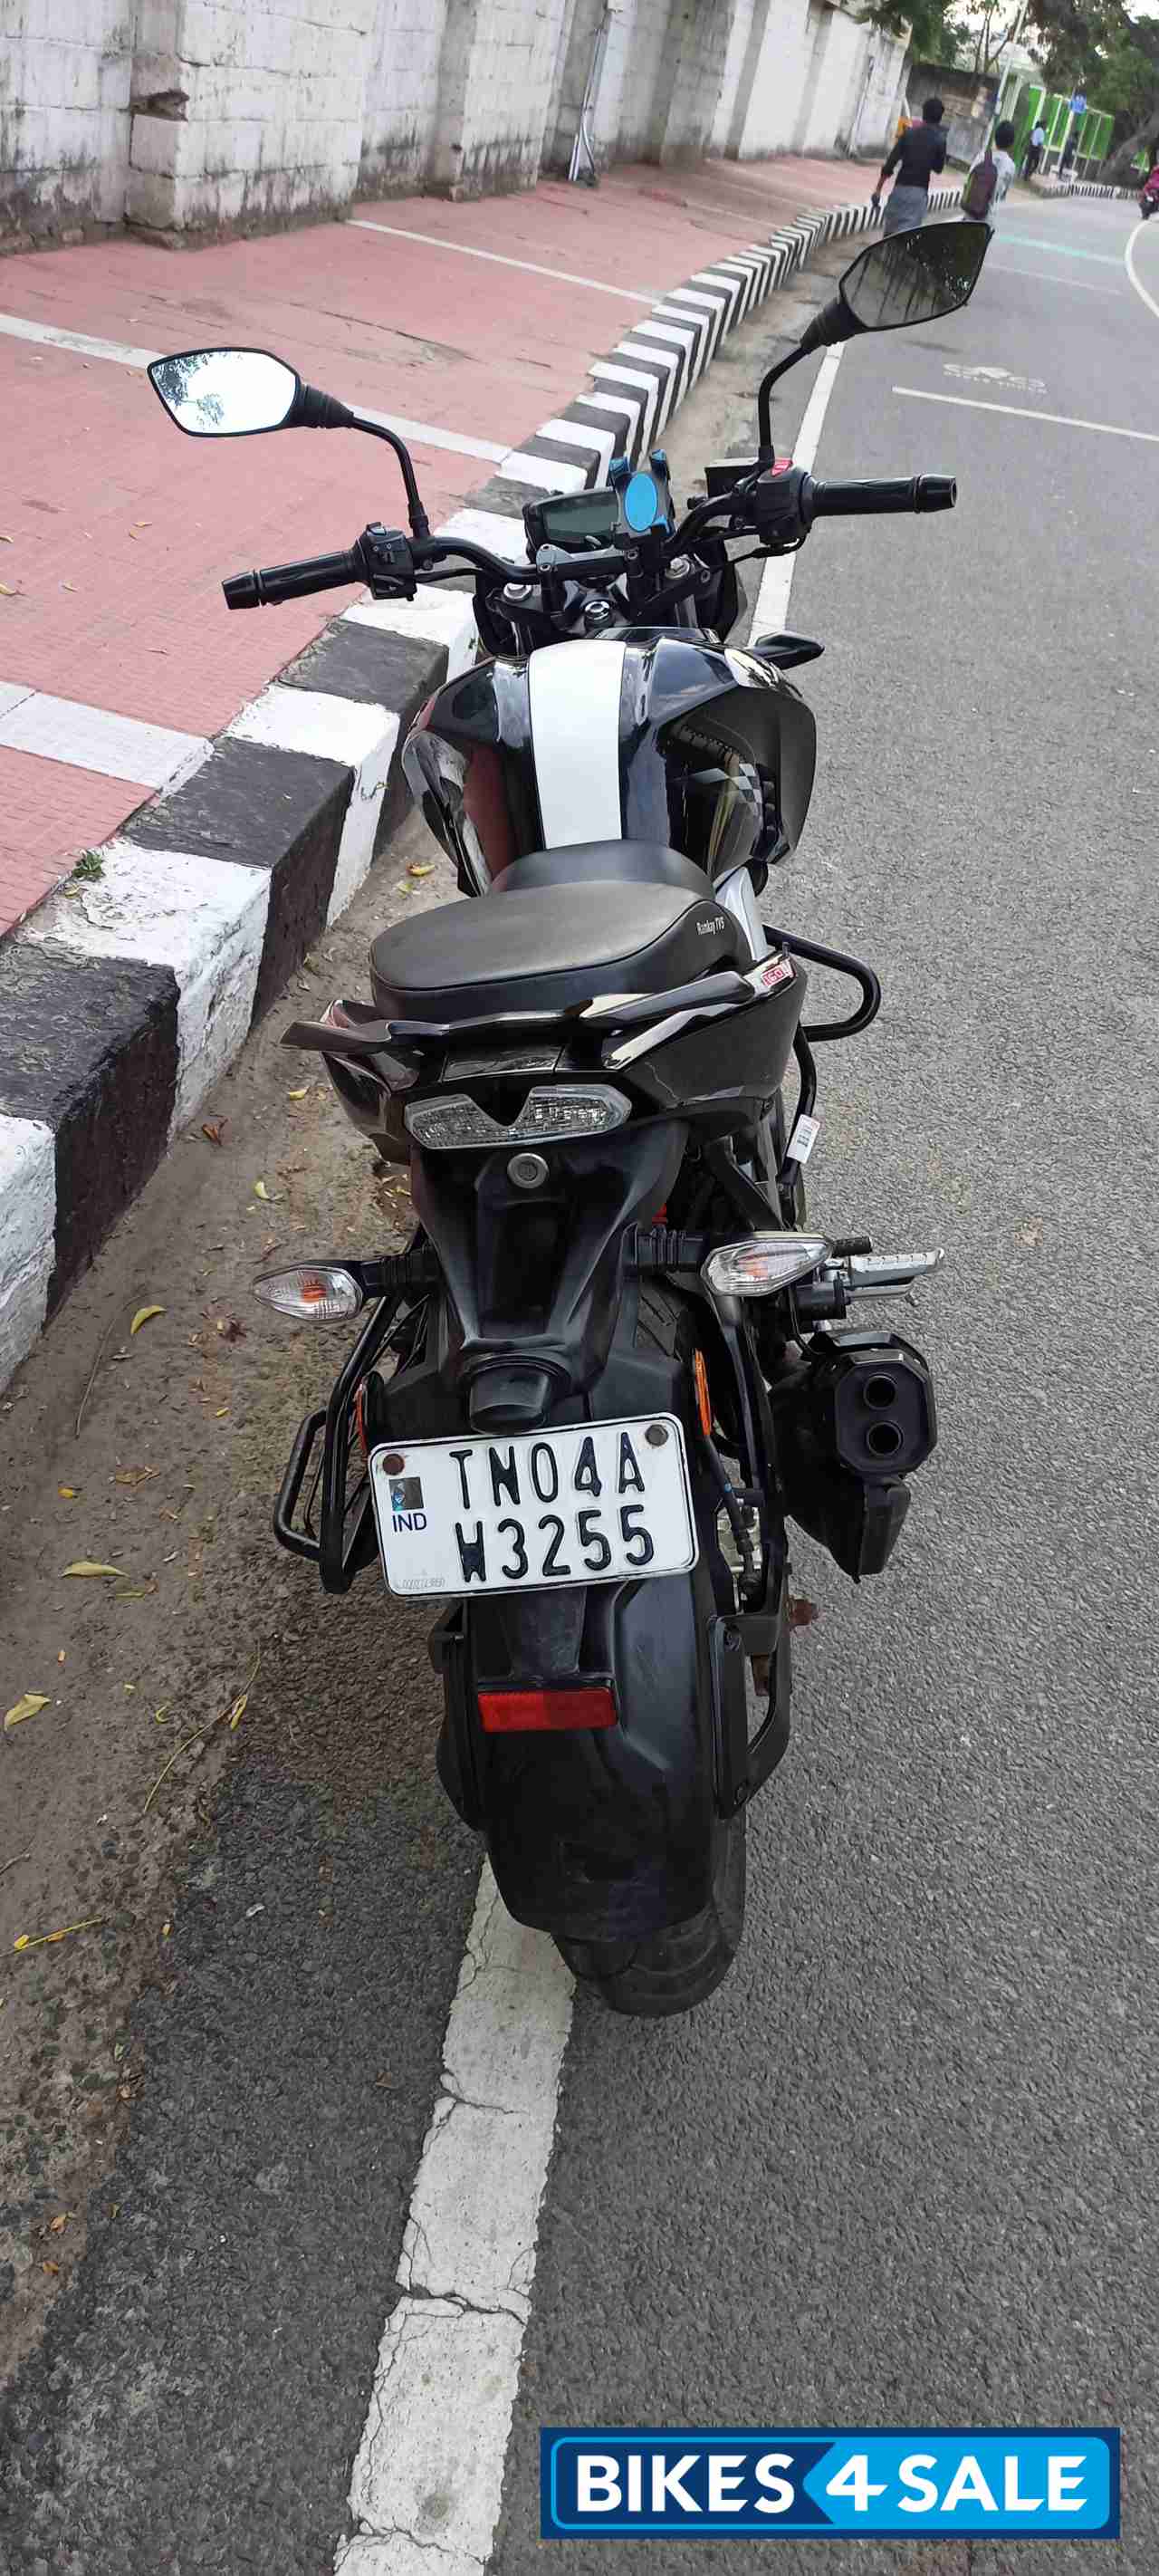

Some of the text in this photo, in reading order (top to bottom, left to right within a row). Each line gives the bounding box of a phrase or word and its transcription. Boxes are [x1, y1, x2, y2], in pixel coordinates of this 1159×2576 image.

[449, 1432, 646, 1510] TN04A
[392, 1512, 427, 1533] IND
[455, 1504, 655, 1583] W3255
